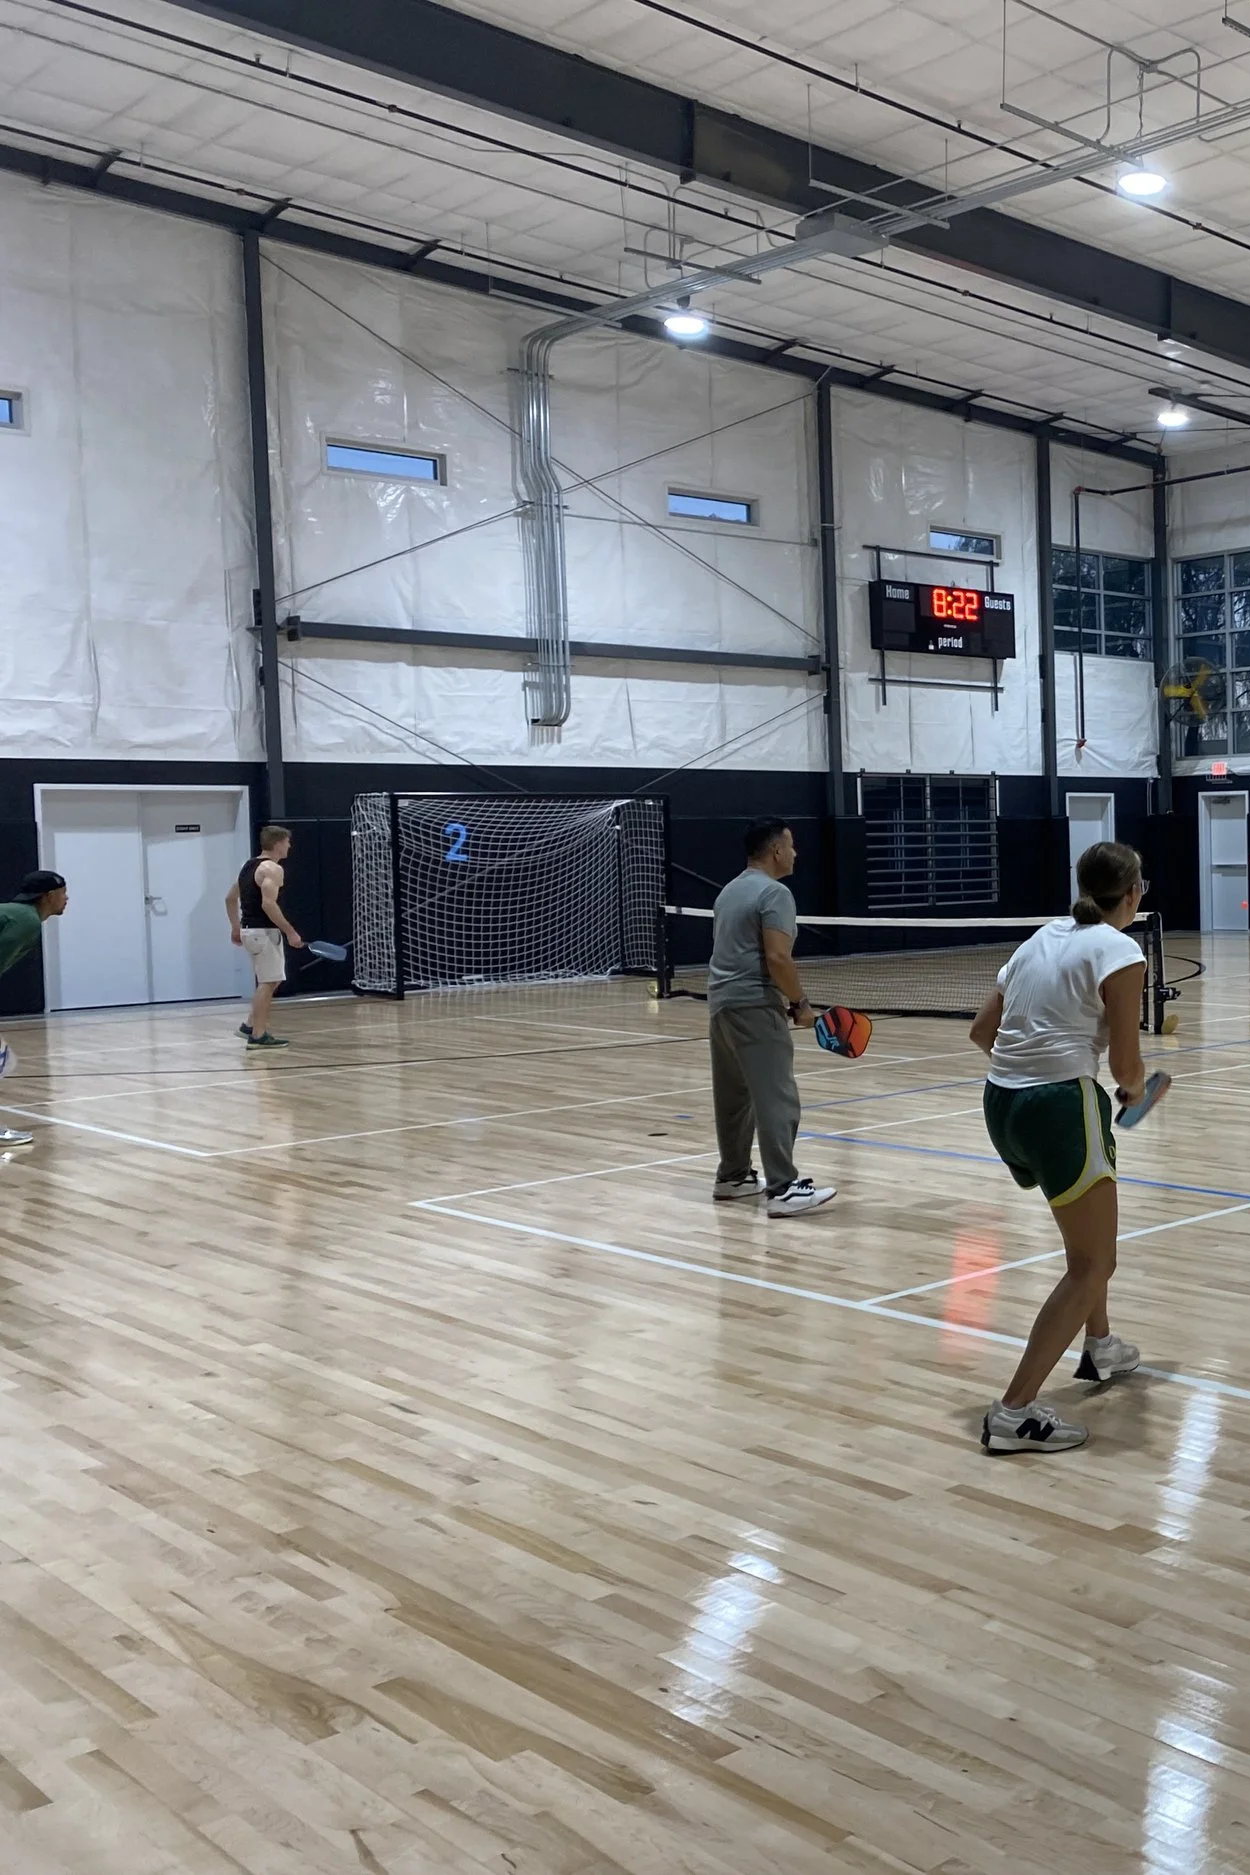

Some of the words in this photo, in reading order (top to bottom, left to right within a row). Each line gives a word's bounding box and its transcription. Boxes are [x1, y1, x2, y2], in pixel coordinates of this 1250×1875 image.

[886, 585, 910, 599] Home
[932, 588, 978, 620] 8:22
[984, 596, 1011, 611] Guests
[938, 636, 963, 649] period
[444, 823, 468, 861] 2
